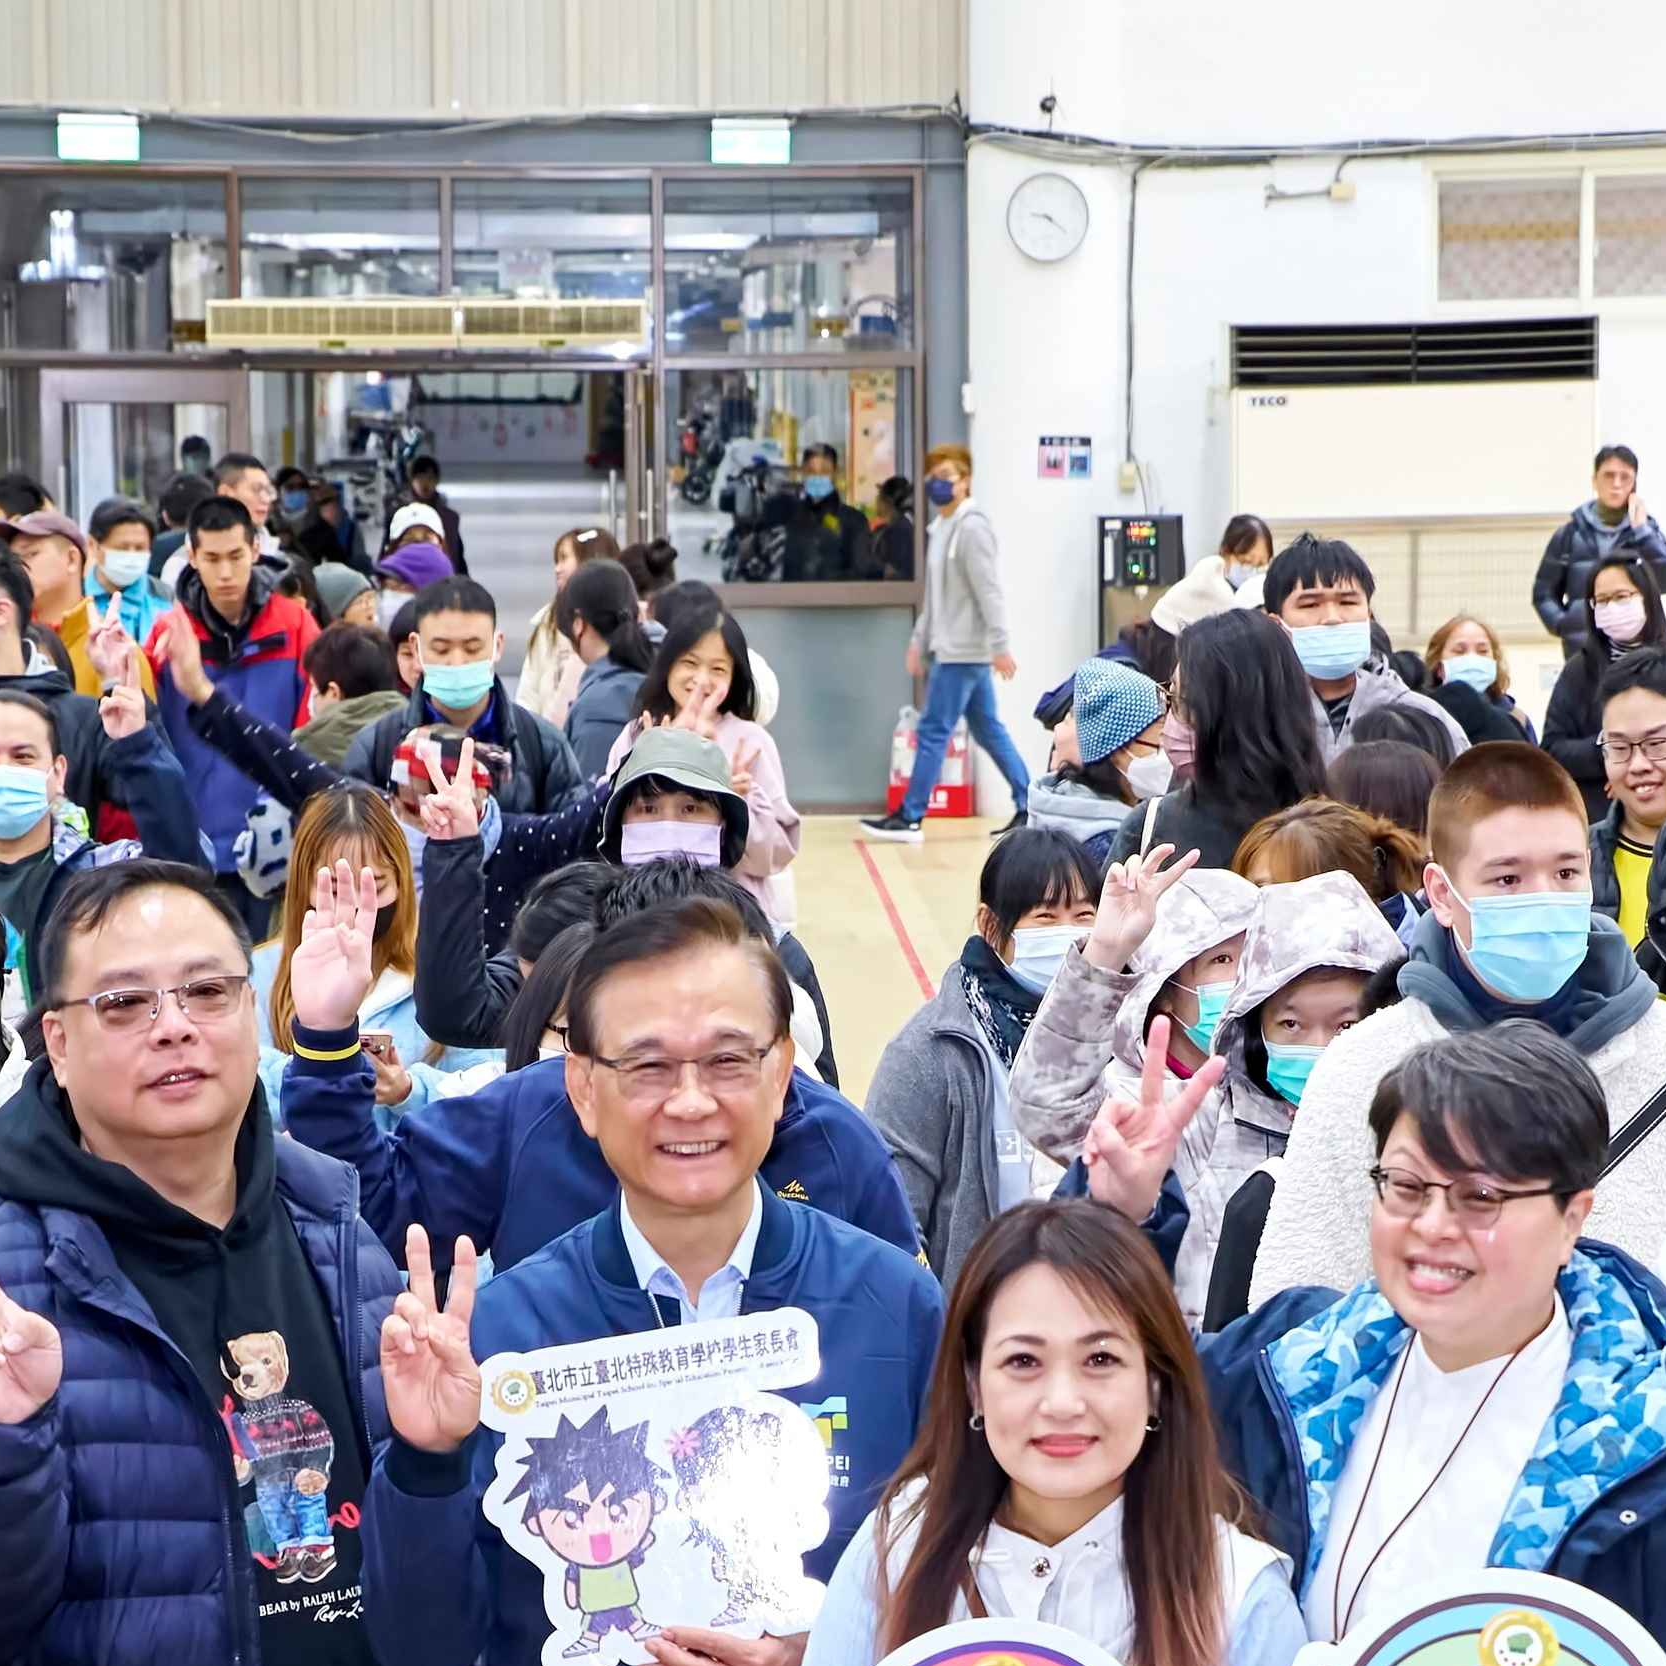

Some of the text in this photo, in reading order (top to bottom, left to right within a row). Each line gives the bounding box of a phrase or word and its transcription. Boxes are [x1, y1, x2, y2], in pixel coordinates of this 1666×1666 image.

[1251, 396, 1287, 406] TECO
[776, 1190, 809, 1201] QUECHUA
[259, 1601, 288, 1617] BEAR
[289, 1600, 300, 1612] by
[302, 1591, 336, 1608] RALPH
